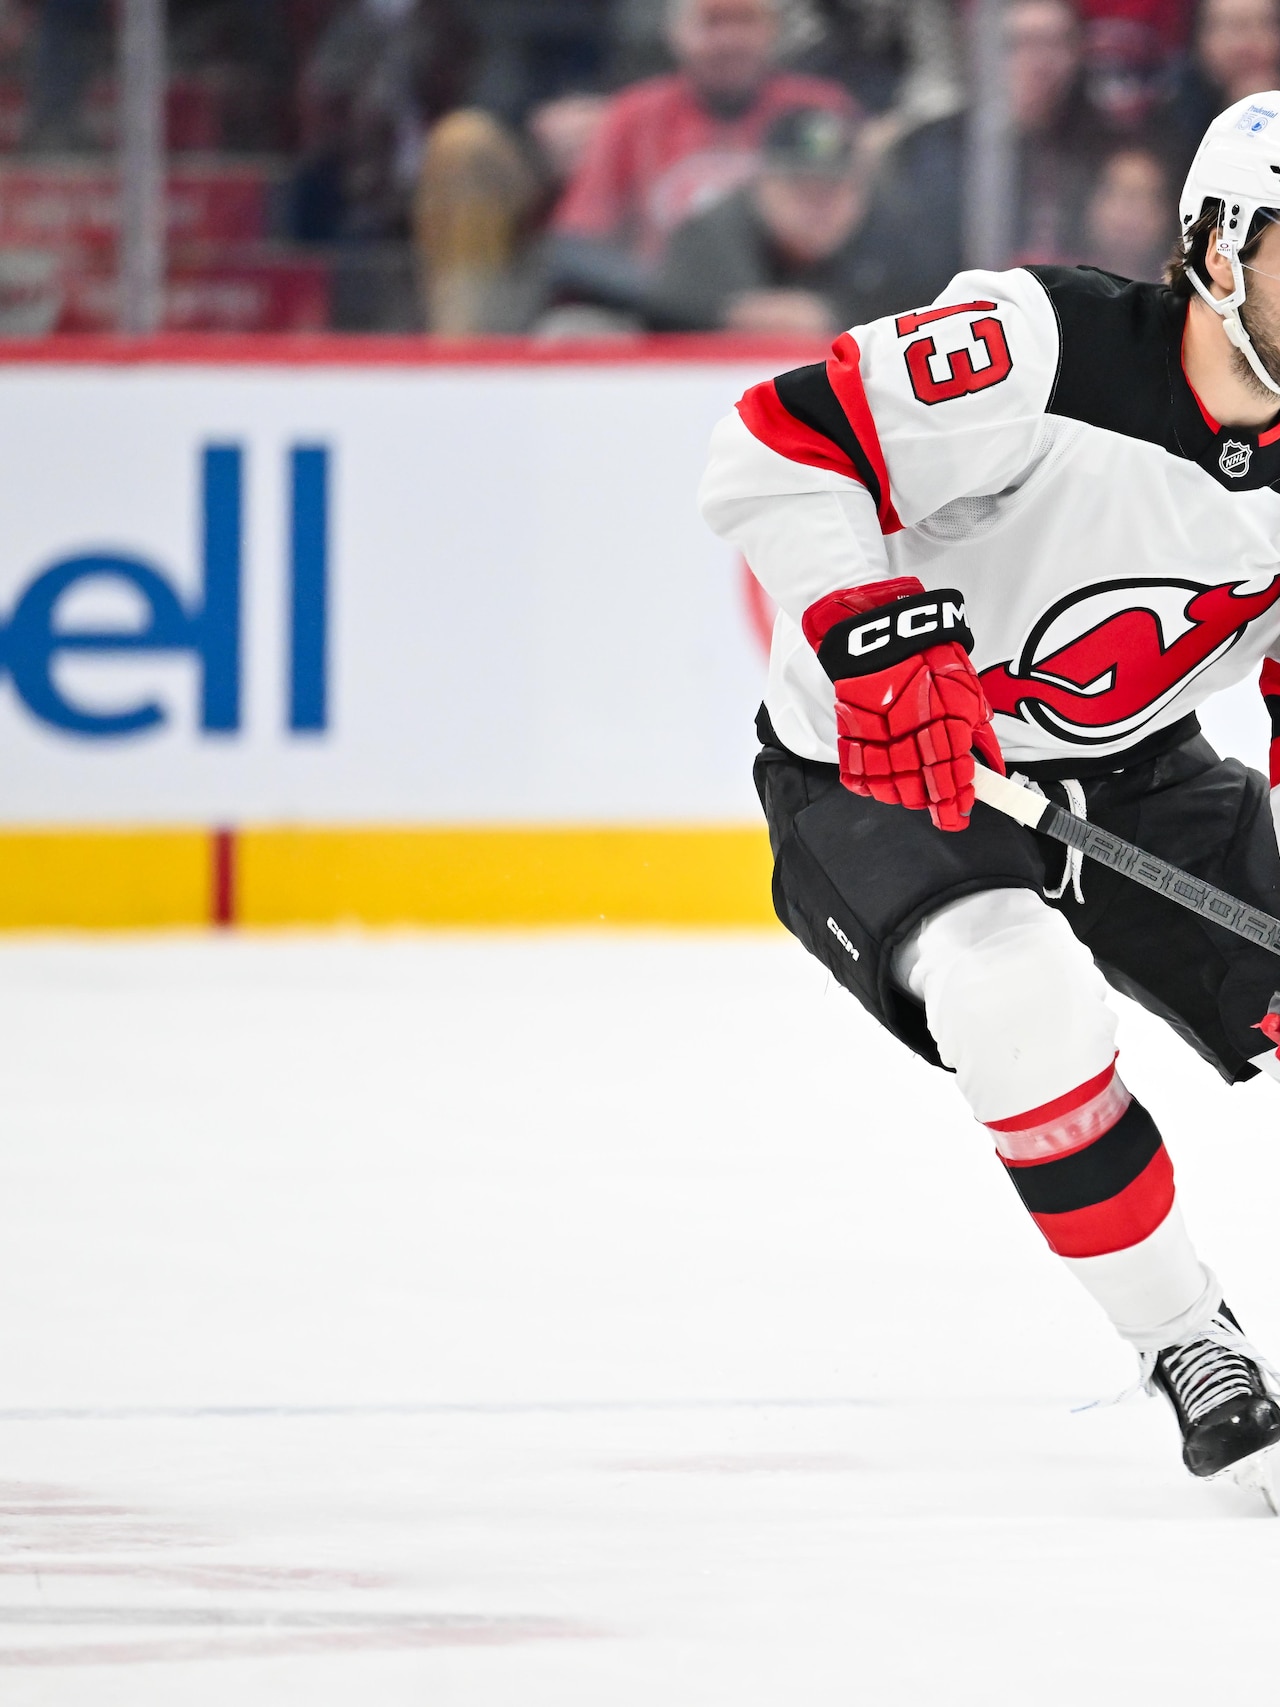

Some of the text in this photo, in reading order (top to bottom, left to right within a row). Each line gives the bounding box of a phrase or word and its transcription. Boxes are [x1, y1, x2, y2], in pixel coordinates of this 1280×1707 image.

[894, 300, 1014, 406] 13
[1225, 452, 1245, 469] NHL
[847, 601, 972, 657] CCM
[1083, 828, 1273, 946] RIBCOR
[826, 916, 861, 962] CCM
